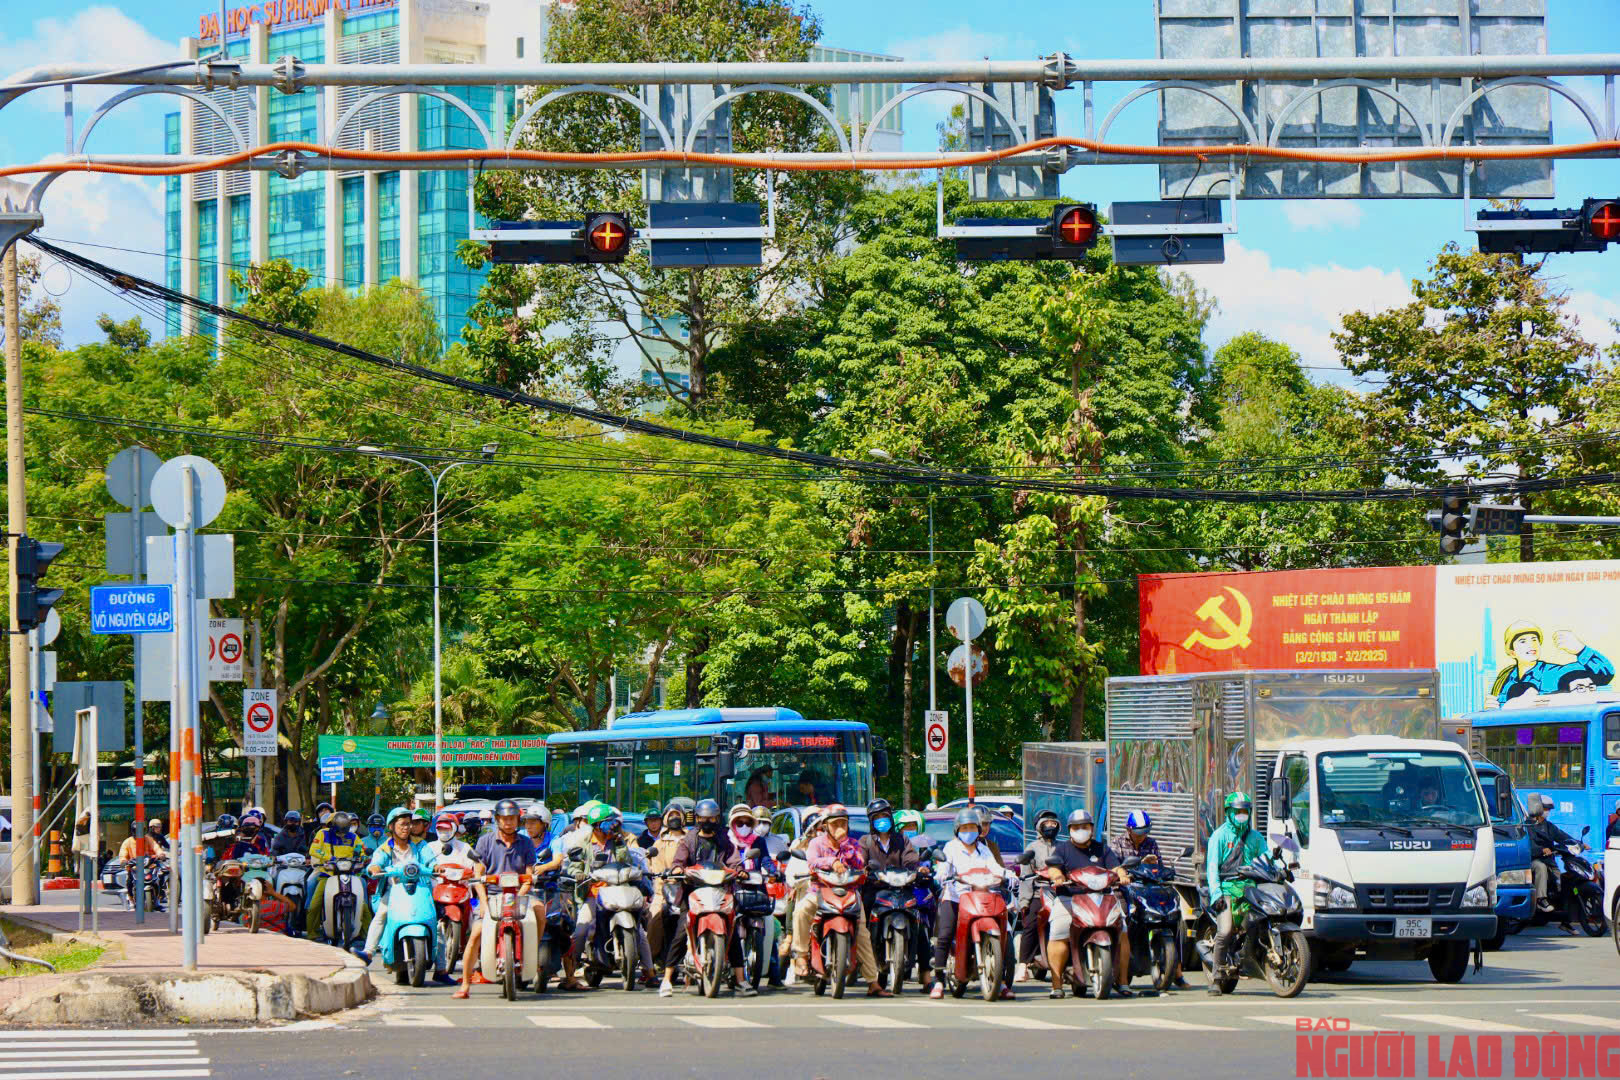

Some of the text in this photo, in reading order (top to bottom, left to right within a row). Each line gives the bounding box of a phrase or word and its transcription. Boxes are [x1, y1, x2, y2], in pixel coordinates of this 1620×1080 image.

[200, 13, 223, 42] ĐẠ
[227, 6, 261, 37] HỌC
[285, 0, 329, 24] PHẠM
[109, 591, 156, 605] ĐƯỜNG
[1272, 590, 1412, 608] NHIỆT LIỆT CHÀO MỪNG 95 NĂM
[94, 608, 170, 628] VÕ NGUYÊN GIÁP
[209, 620, 226, 628] ZONE
[1303, 609, 1379, 626] NGÀY THÀNH LẬP
[1283, 628, 1400, 646] ĐẢNG CỘNG SẢN VIỆT NAM
[1295, 651, 1337, 663] (3/2/1930
[1345, 649, 1388, 662] 3/2/2025)
[1324, 674, 1365, 683] ISUZU
[251, 692, 270, 701] ZONE
[387, 741, 412, 750] CHUNG
[414, 740, 426, 750] TAY
[427, 740, 448, 750] PHN
[744, 736, 759, 749] 57
[1390, 840, 1432, 850] ISUZU
[1406, 919, 1422, 928] 95C
